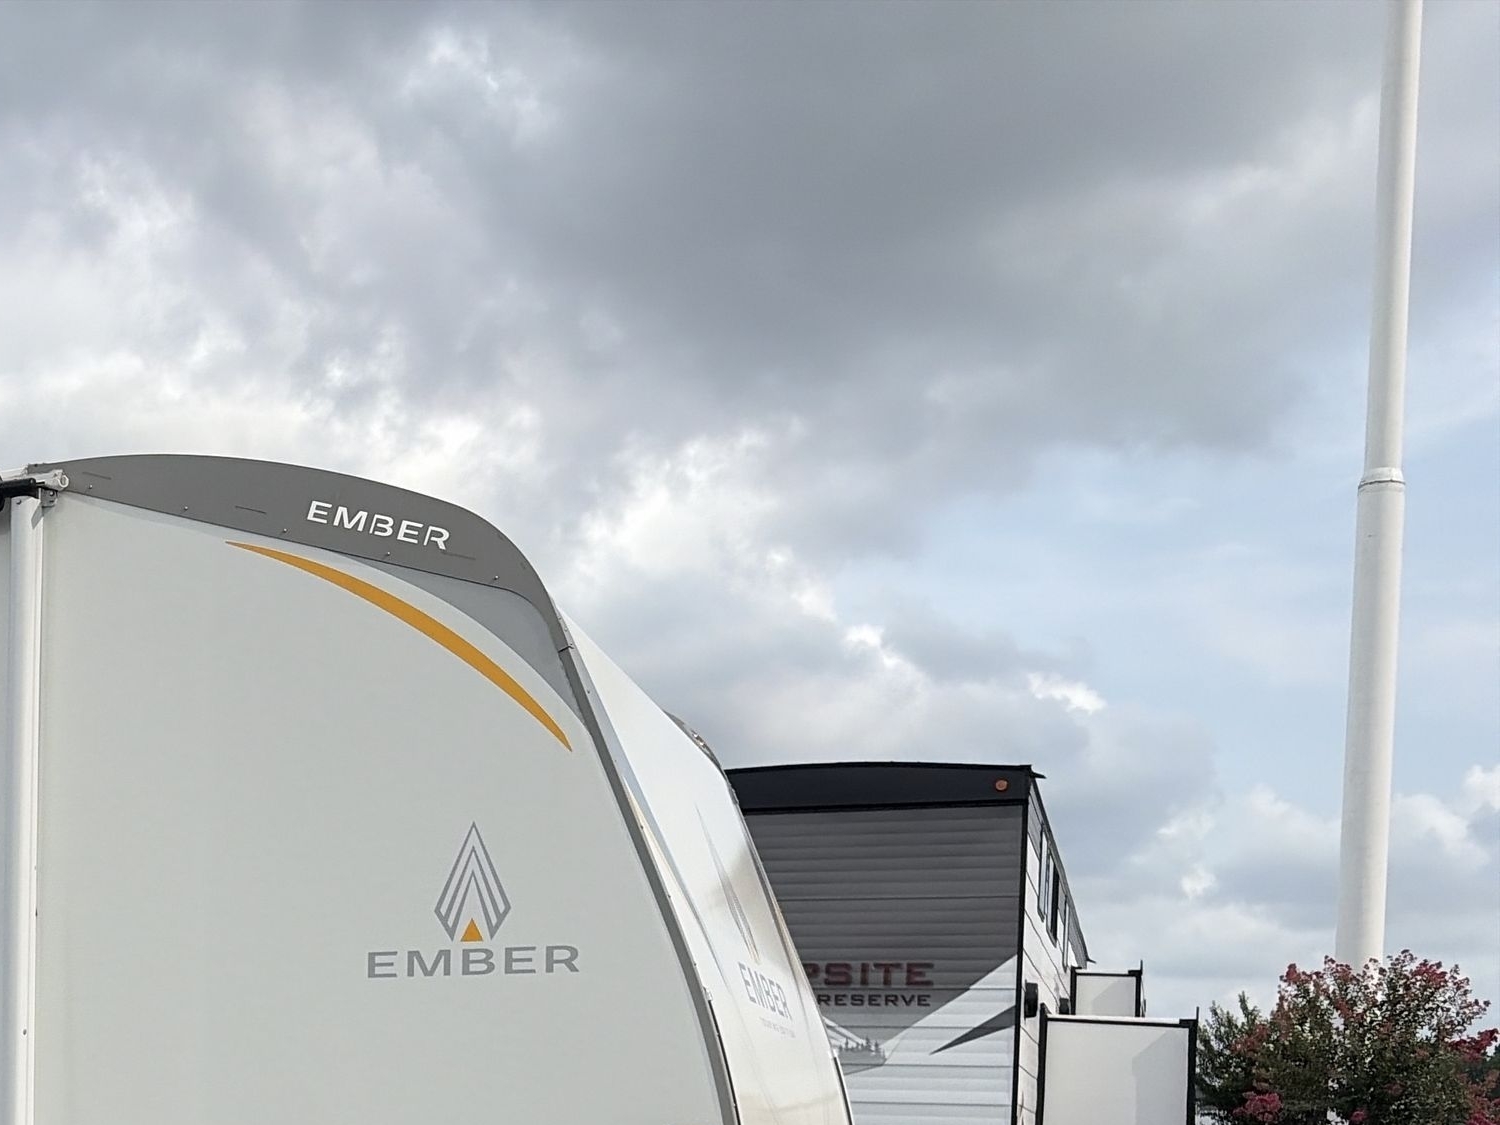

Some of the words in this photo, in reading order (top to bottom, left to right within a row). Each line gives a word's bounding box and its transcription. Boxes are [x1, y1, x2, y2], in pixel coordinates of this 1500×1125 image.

[306, 500, 450, 550] EMBER
[367, 945, 580, 978] EMBER
[738, 961, 793, 1020] EMBER
[817, 994, 932, 1007] RESERVE
